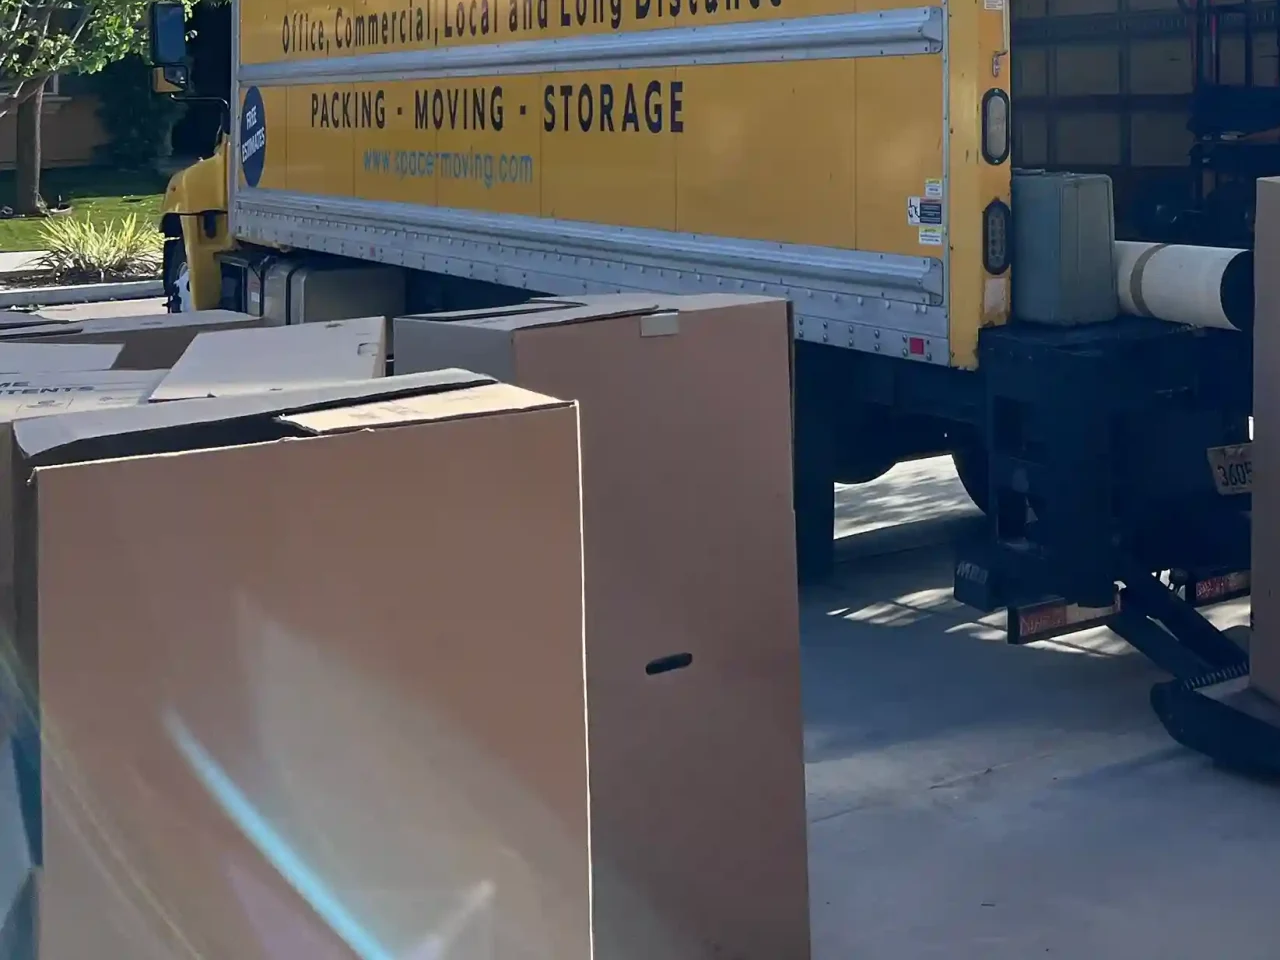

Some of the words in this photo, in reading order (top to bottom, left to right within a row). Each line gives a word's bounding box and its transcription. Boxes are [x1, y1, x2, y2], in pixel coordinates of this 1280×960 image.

[282, 10, 330, 55] Office,
[246, 105, 257, 130] FREE
[311, 90, 386, 130] PACKING
[415, 86, 504, 131] MOVING
[544, 80, 684, 134] STORAGE
